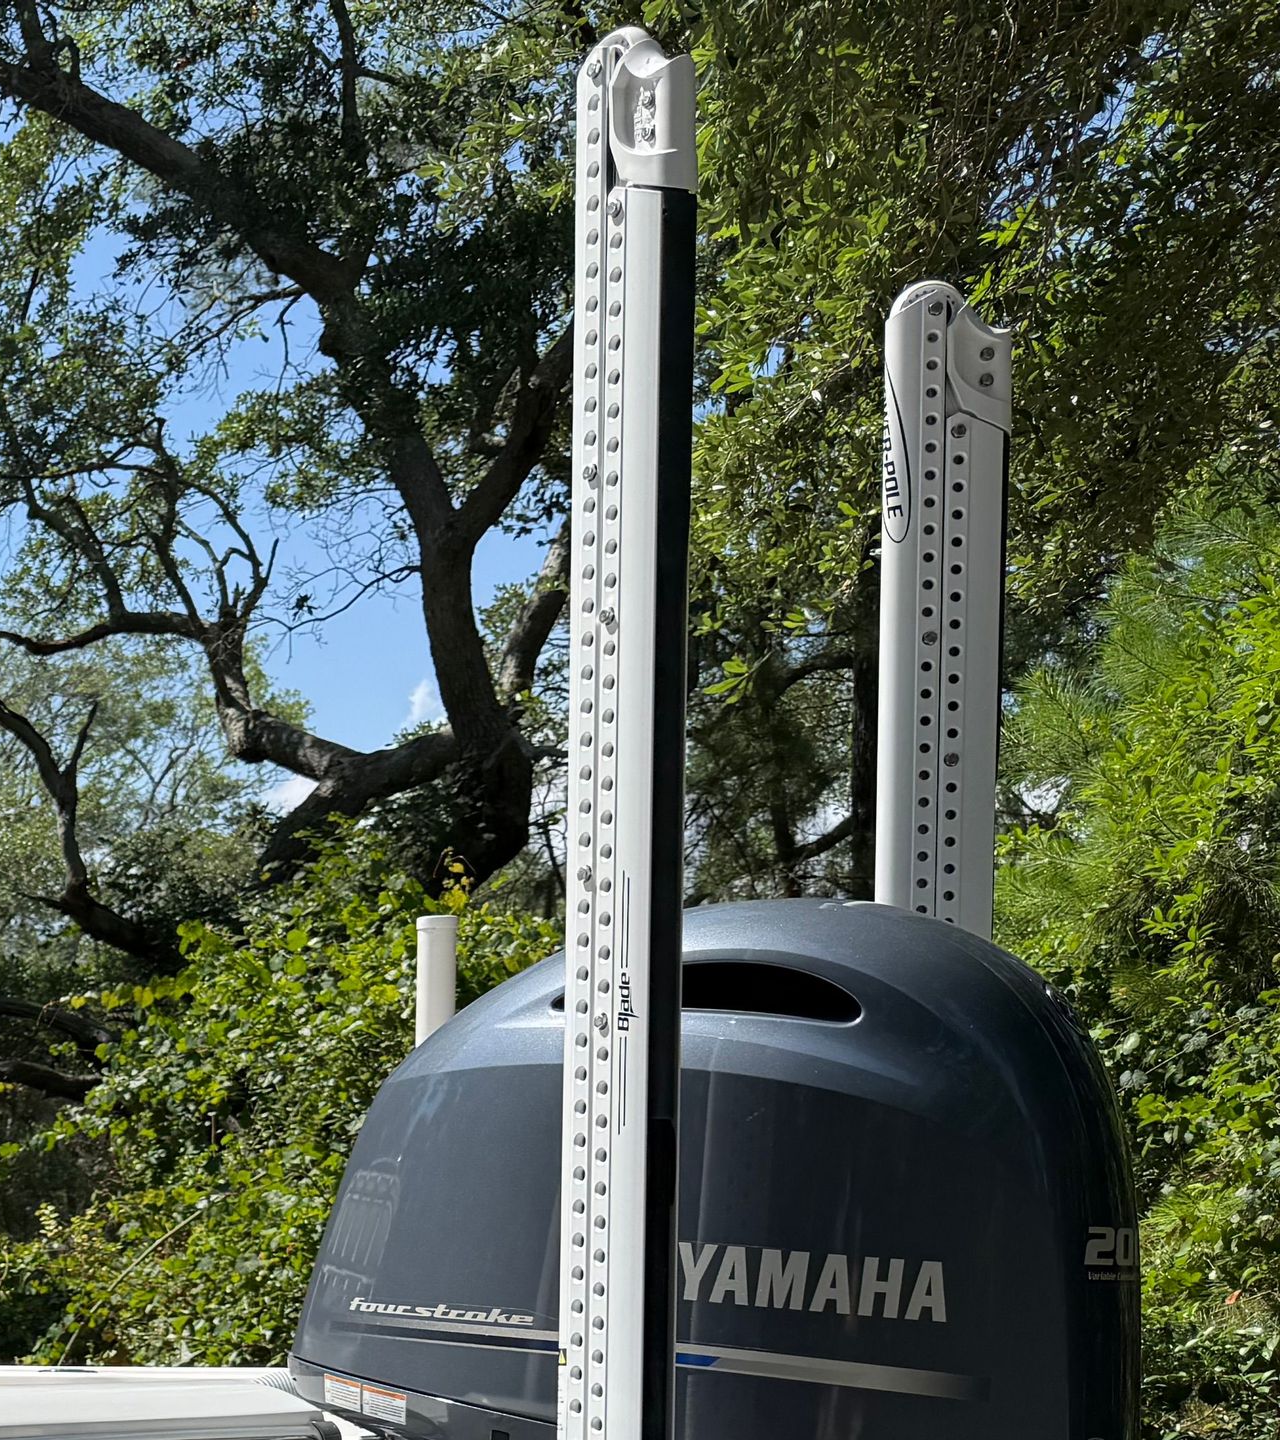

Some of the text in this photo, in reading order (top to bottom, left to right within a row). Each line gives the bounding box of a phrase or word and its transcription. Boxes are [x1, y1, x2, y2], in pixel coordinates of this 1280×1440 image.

[617, 972, 637, 1031] Blade
[1084, 1226, 1138, 1266] 20
[678, 1242, 947, 1322] YAMAHA
